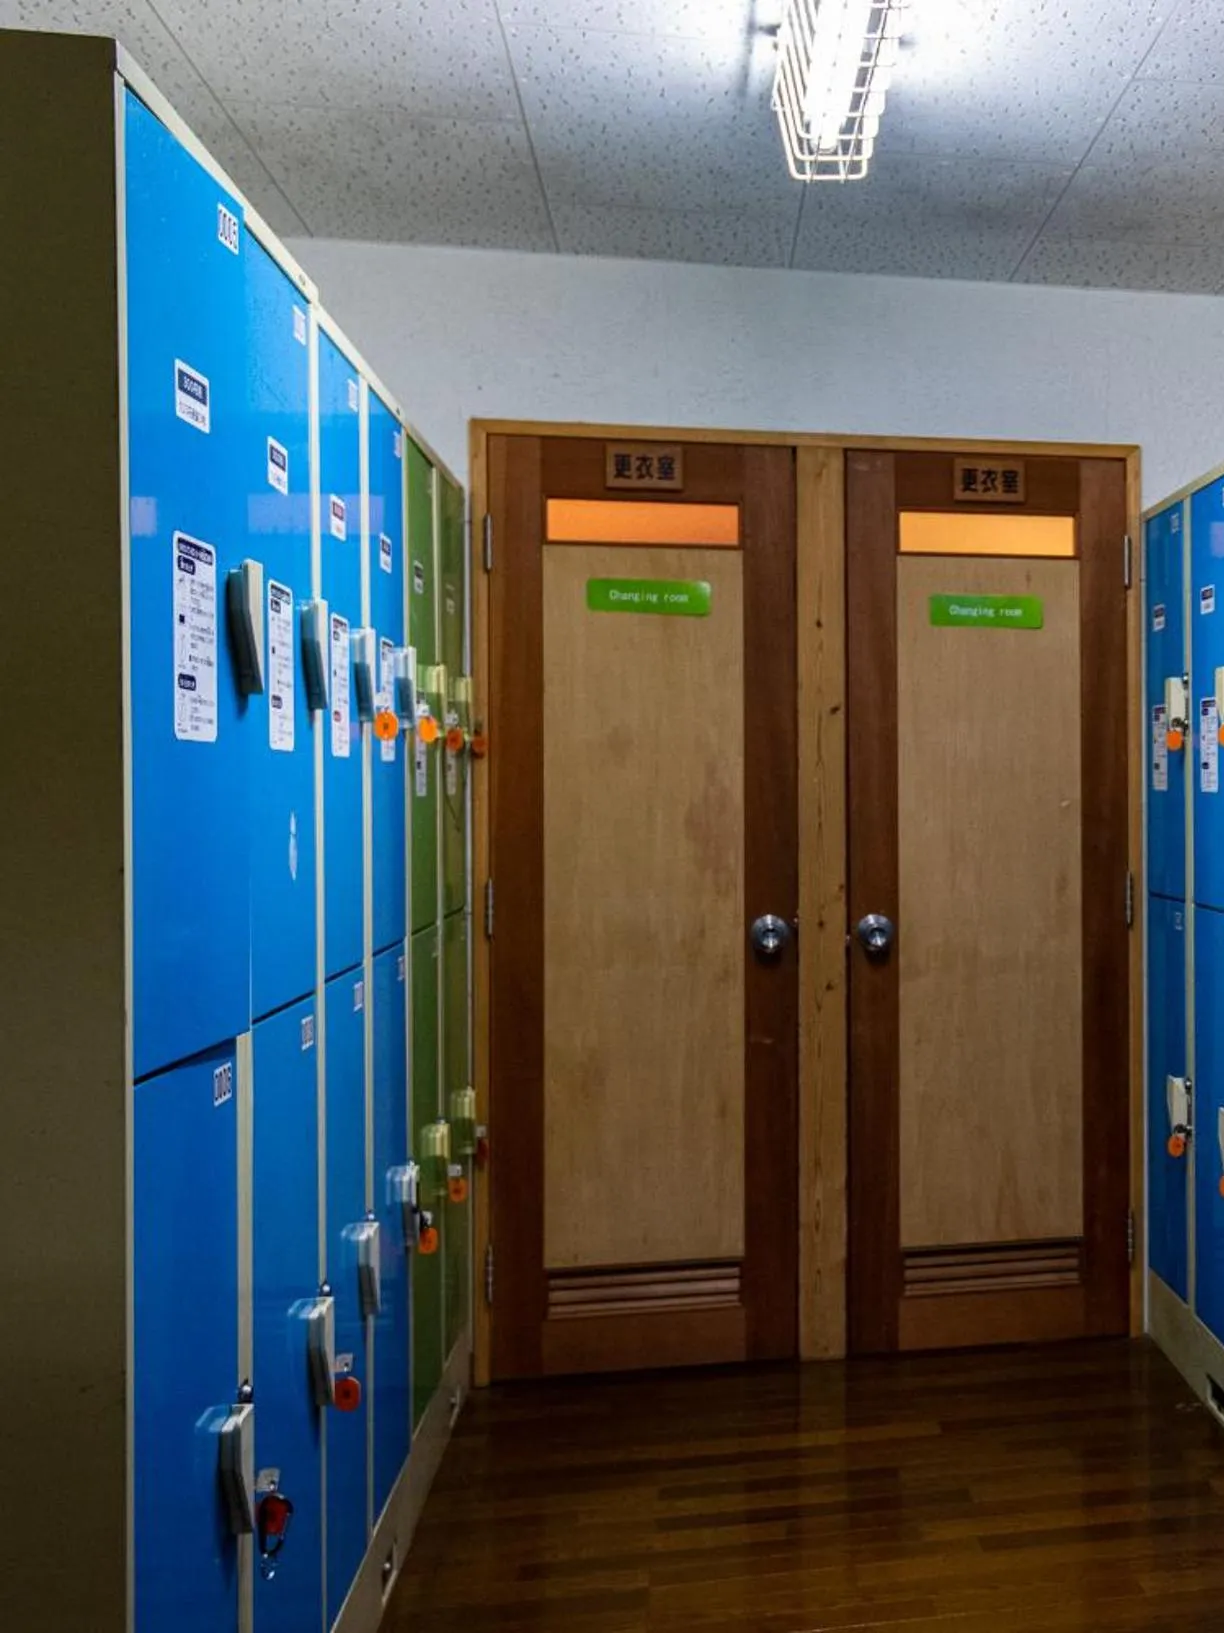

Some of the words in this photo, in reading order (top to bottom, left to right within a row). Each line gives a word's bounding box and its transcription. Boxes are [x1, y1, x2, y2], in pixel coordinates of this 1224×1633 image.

[614, 454, 675, 481] 更衣室
[961, 468, 1019, 494] 更衣室
[609, 589, 658, 603] Changing
[663, 593, 689, 603] room
[949, 604, 995, 618] Changing
[1000, 606, 1023, 617] room
